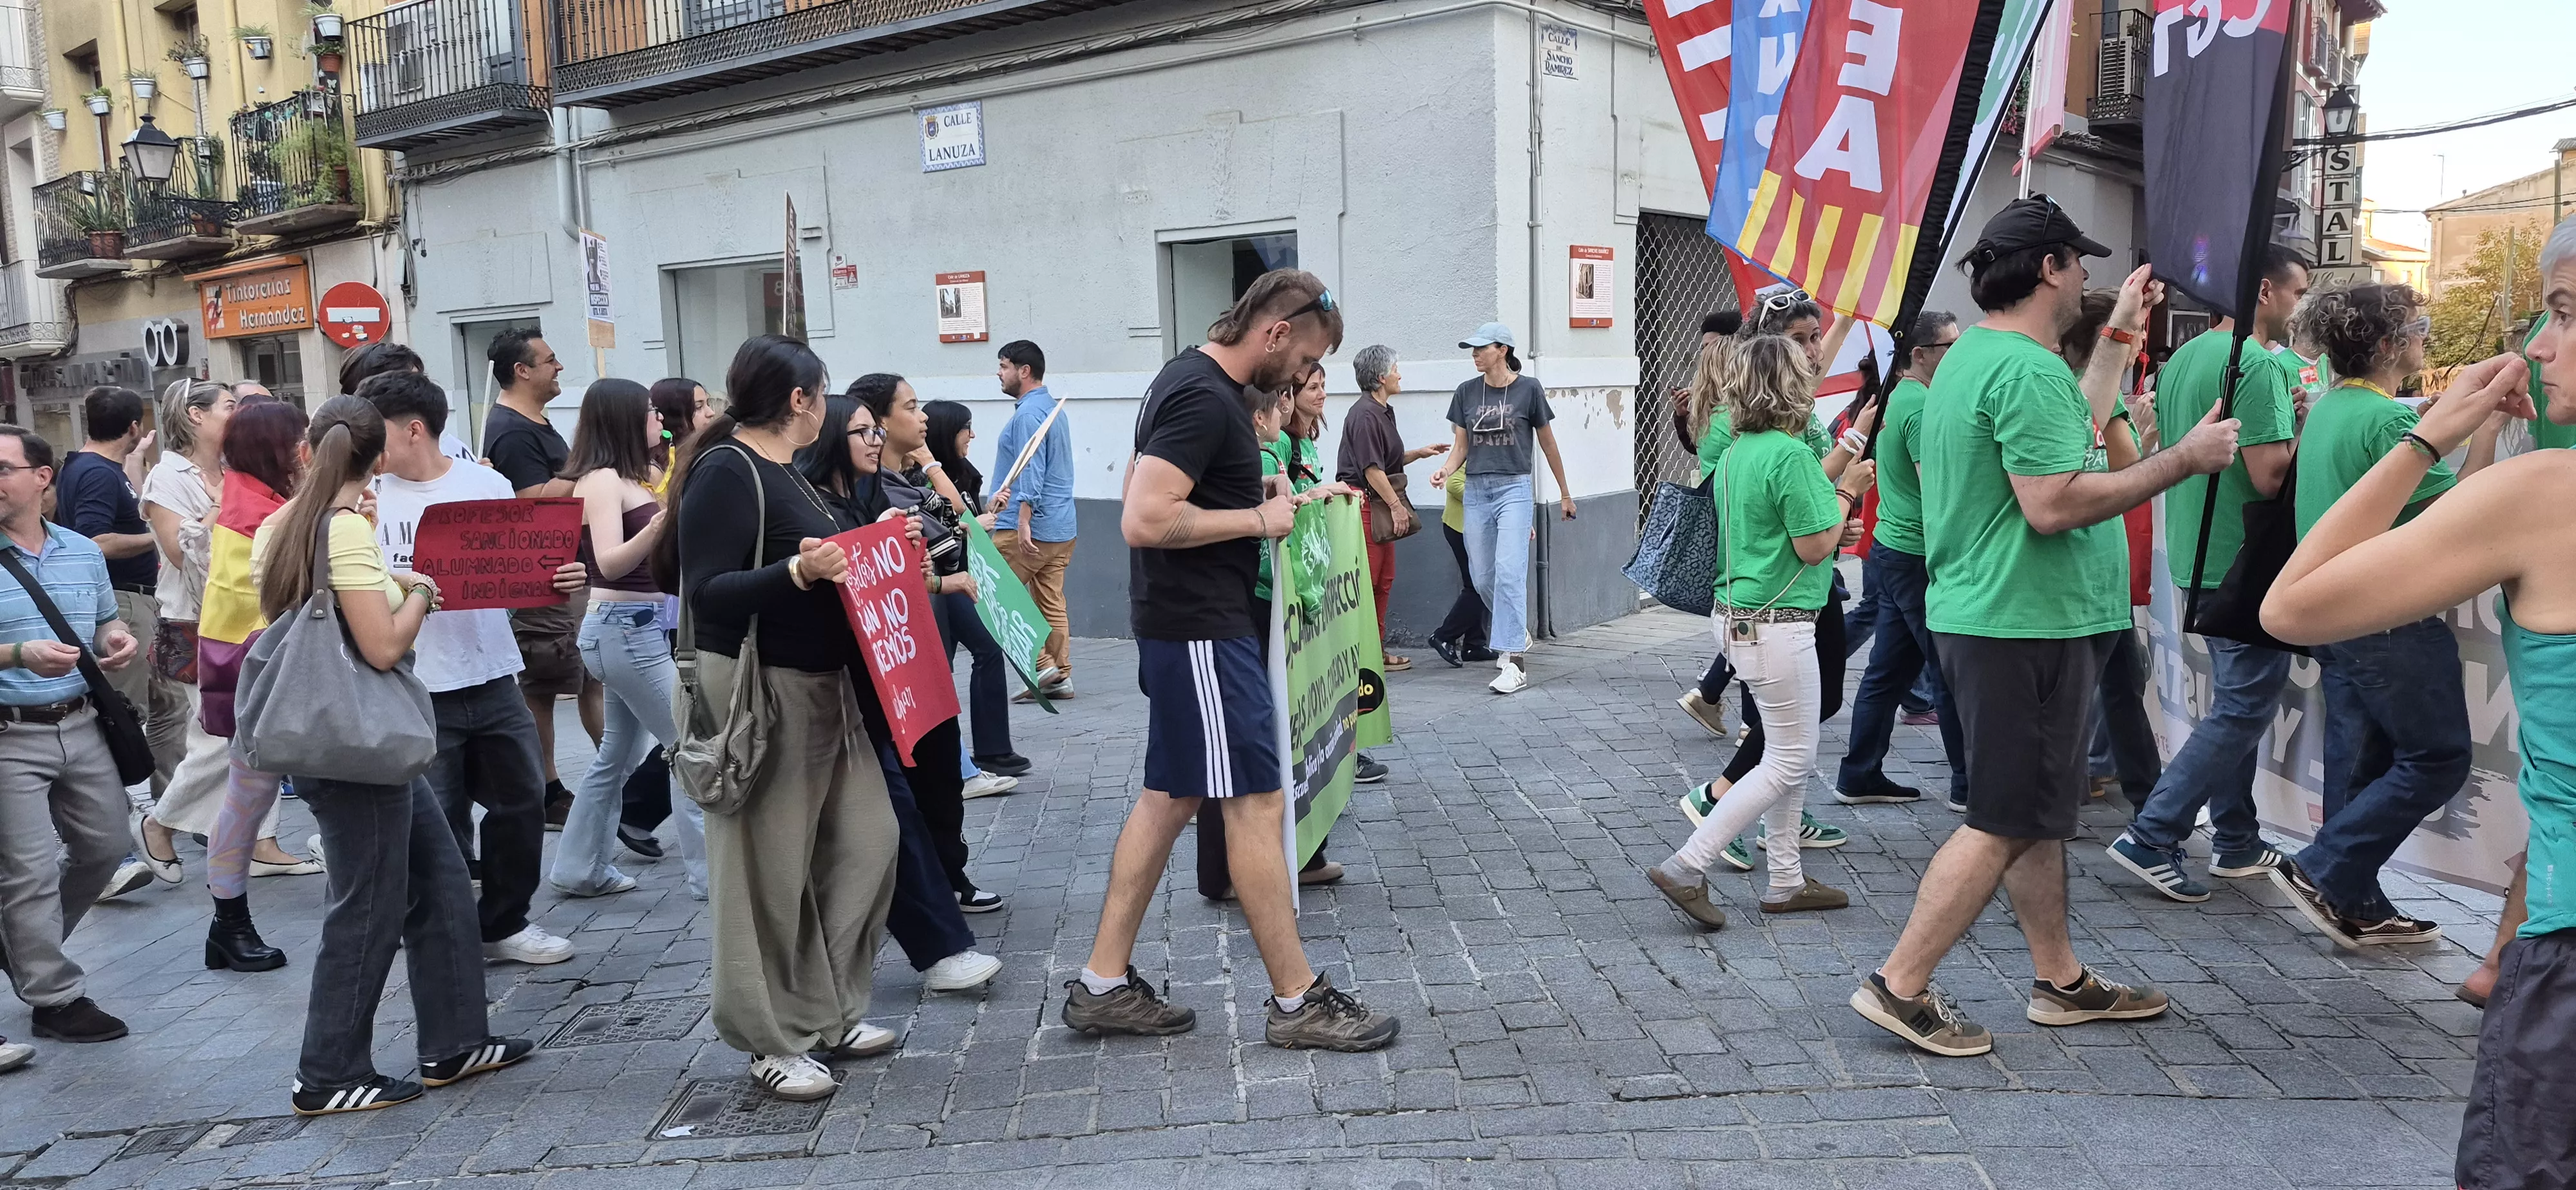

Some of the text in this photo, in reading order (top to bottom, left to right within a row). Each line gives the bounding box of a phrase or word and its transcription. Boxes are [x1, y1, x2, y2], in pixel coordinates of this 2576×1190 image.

[1548, 32, 1571, 46] CALLE
[1546, 50, 1573, 65] SANCHO
[943, 112, 972, 128] CALLE
[929, 142, 976, 162] LANUZA
[225, 276, 291, 303] Tintorerías
[240, 303, 306, 329] Hernández
[1473, 433, 1515, 446] PATH
[424, 504, 534, 526] PROFESOR
[421, 557, 533, 576] ALUMNADO
[871, 536, 906, 580] NO
[880, 588, 909, 633] NO
[1341, 648, 1350, 679] Y
